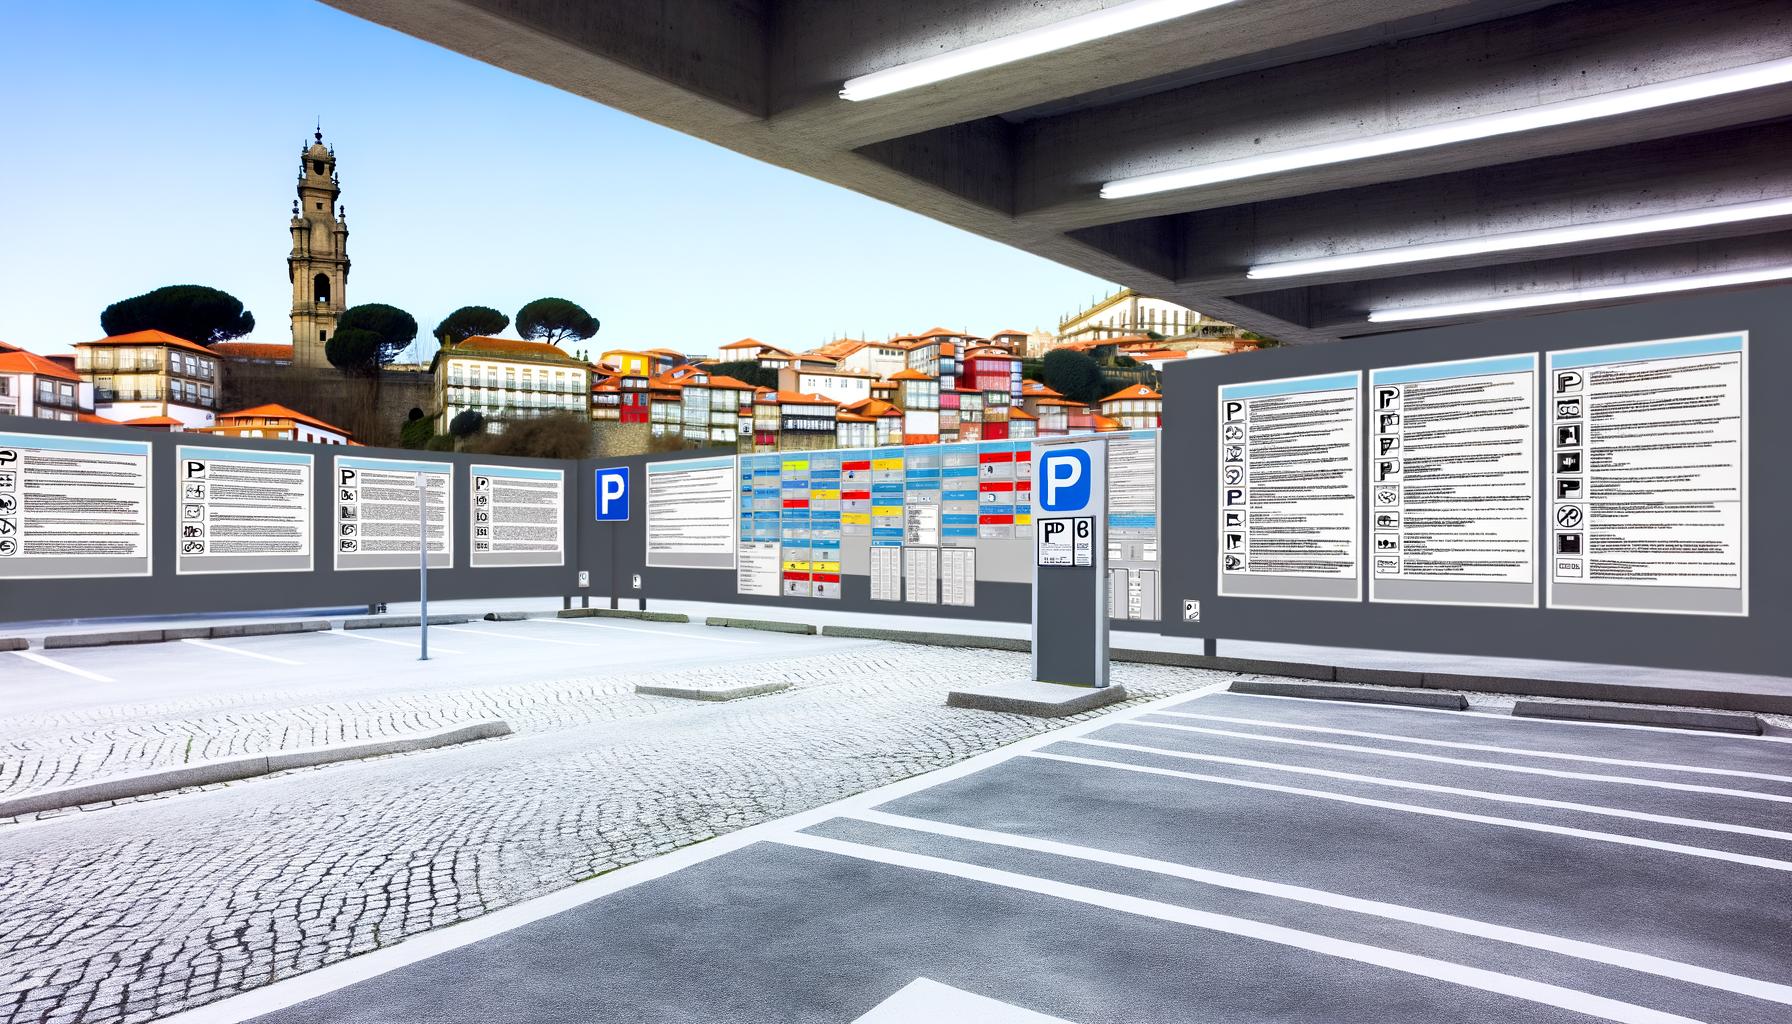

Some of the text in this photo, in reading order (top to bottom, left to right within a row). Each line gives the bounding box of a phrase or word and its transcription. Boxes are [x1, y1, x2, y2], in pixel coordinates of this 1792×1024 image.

[1226, 402, 1242, 421] P
[188, 461, 205, 478] P
[341, 469, 355, 485] P
[1047, 456, 1082, 506] P
[602, 474, 624, 514] P
[1227, 489, 1243, 506] P
